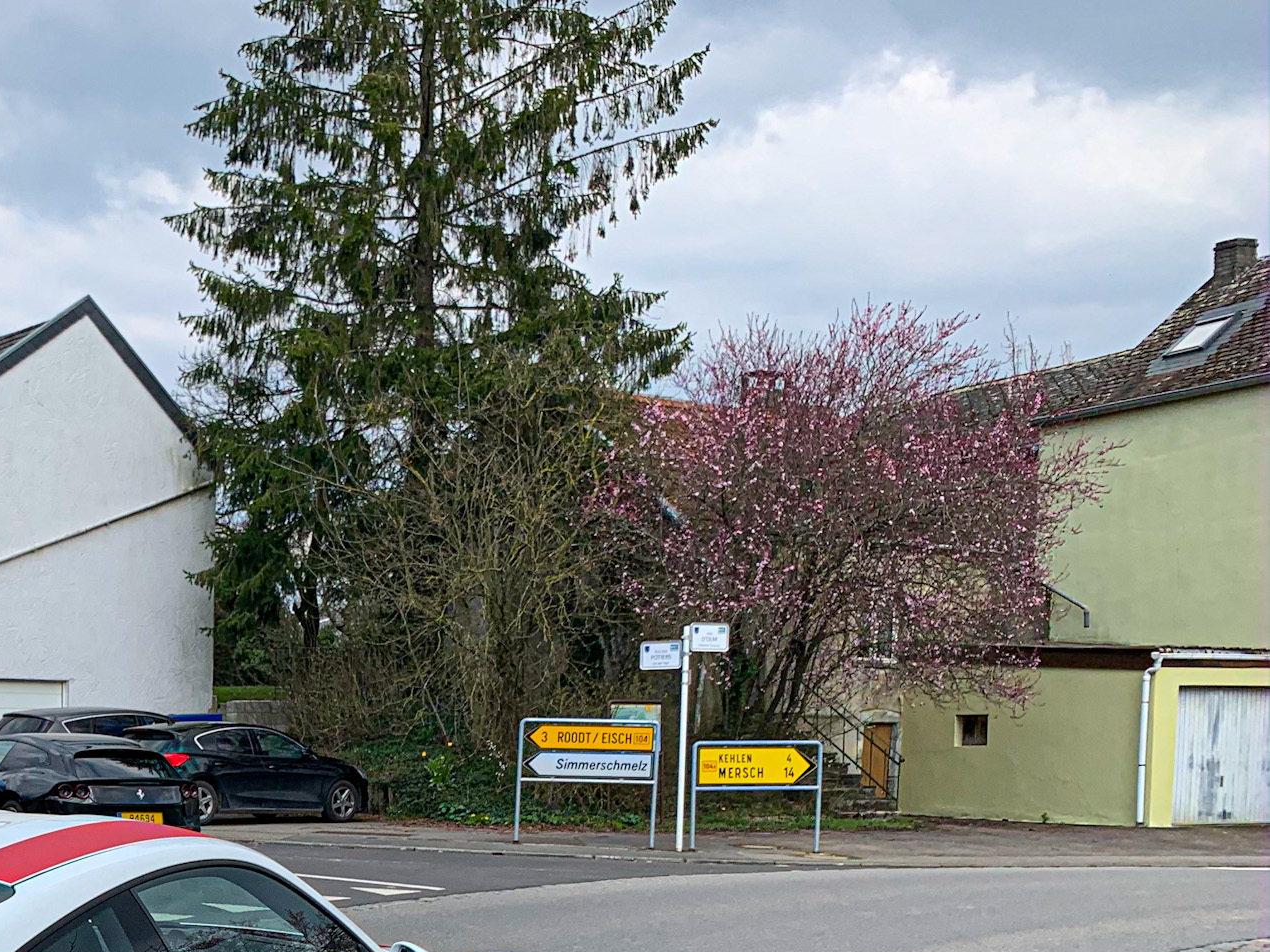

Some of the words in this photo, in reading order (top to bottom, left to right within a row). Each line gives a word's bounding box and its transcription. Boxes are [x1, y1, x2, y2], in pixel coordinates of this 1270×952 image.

[541, 731, 548, 743] 3
[557, 731, 591, 744] ROODT
[601, 732, 632, 745] EISCH
[635, 735, 648, 743] 104
[718, 754, 752, 763] KEHLEN
[786, 753, 792, 763] 4
[555, 758, 648, 772] Simmerschmelz
[718, 767, 764, 779] MERSCH
[784, 766, 795, 778] 14
